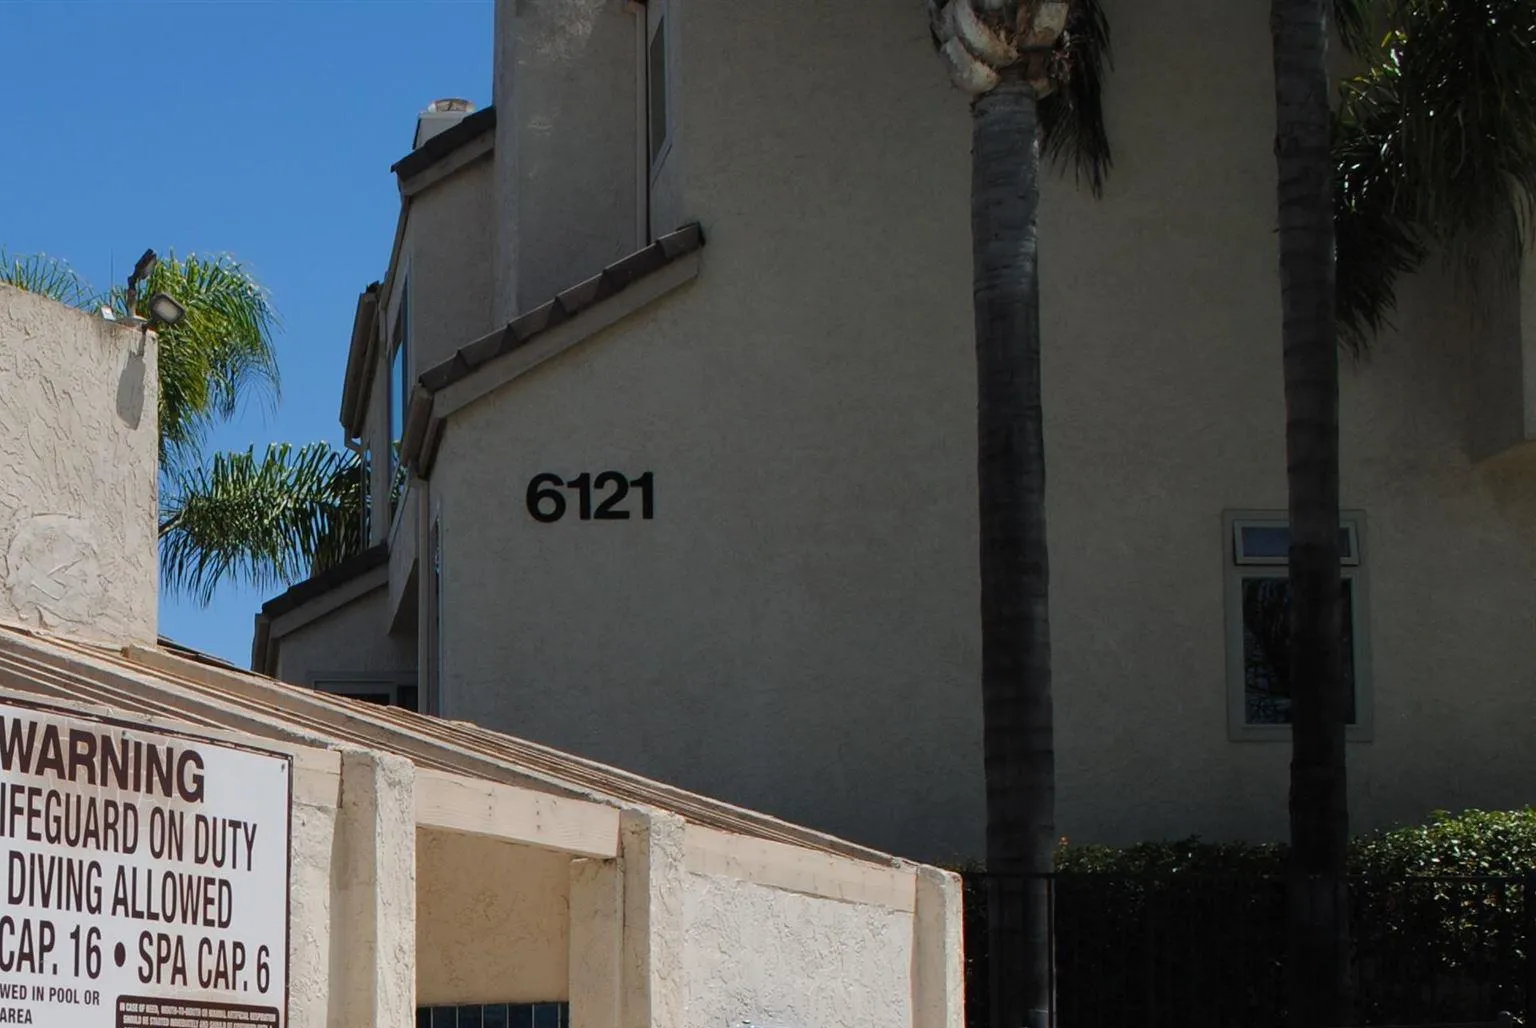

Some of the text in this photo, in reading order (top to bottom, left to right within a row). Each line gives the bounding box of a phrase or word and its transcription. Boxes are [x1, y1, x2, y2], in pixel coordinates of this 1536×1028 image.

[526, 471, 653, 523] 6121
[149, 805, 183, 862] ON
[194, 813, 256, 872] DUTY
[8, 849, 102, 914] DIVING
[111, 863, 232, 929] ALLOWED
[69, 924, 101, 979] 16
[138, 930, 187, 986] SPA
[197, 936, 247, 992] CAP.
[256, 944, 269, 994] 6
[0, 1007, 32, 1024] AREA
[32, 985, 43, 1001] IN
[49, 987, 79, 1004] POOL
[84, 990, 99, 1005] OR
